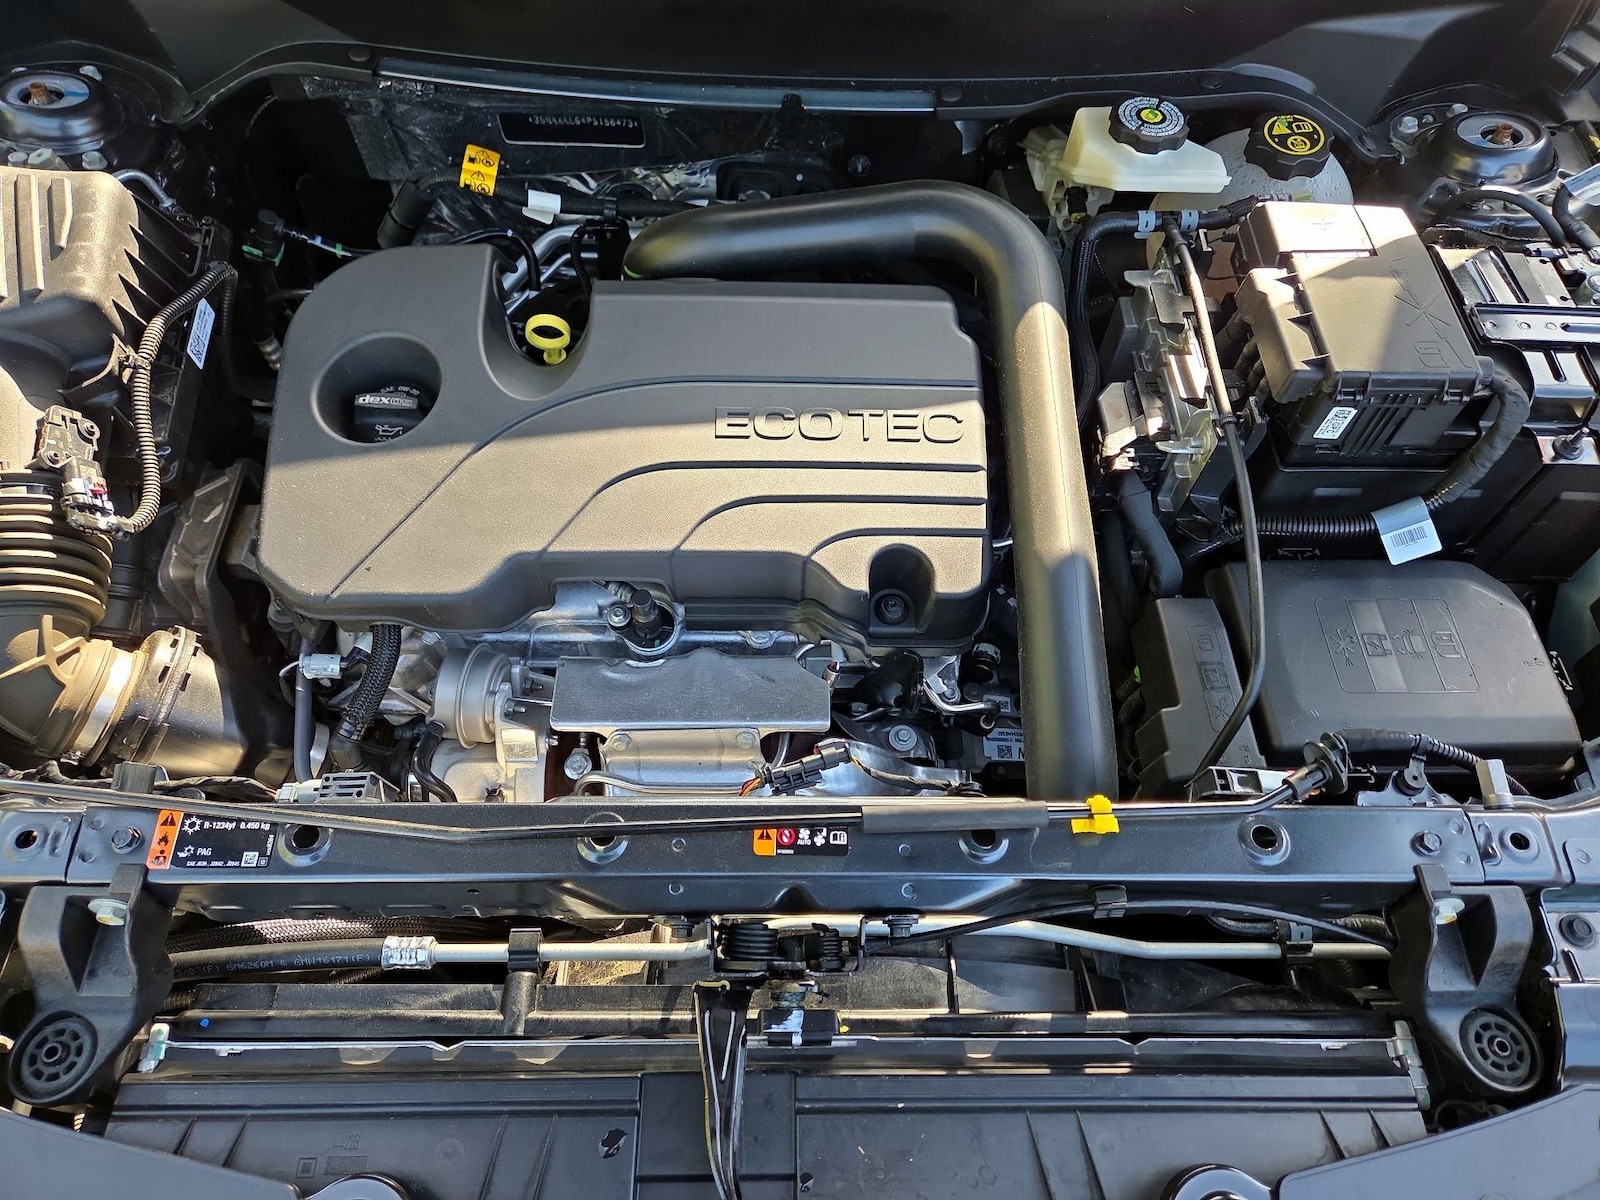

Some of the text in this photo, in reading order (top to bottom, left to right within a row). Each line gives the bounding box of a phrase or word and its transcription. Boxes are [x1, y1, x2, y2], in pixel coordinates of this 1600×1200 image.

[714, 406, 965, 444] ECOTEC
[203, 821, 271, 831] R-1234yf 0.450 kg
[196, 847, 212, 856] PAG
[226, 959, 275, 971] GM6260M
